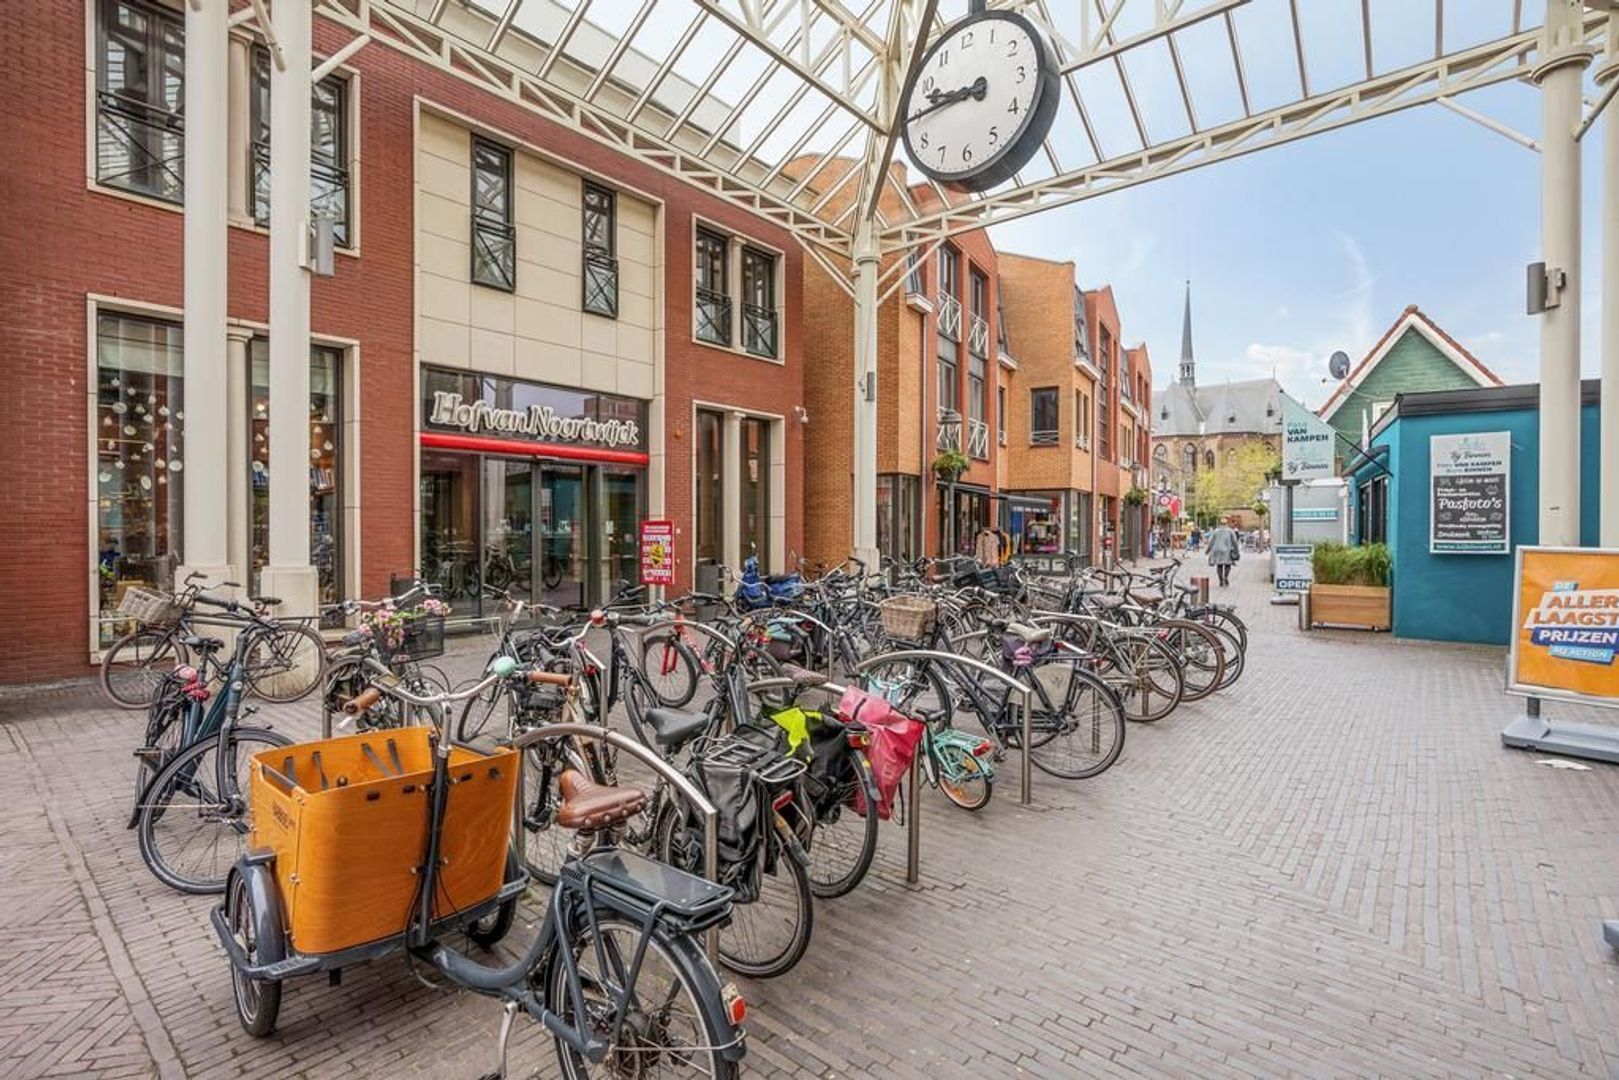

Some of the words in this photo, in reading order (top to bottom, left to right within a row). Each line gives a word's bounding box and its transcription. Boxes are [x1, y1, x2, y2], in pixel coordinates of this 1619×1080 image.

[960, 31, 974, 50] 12
[989, 28, 995, 44] 1
[1006, 40, 1018, 57] 2
[938, 50, 949, 67] 11
[1015, 66, 1026, 84] 3
[921, 76, 934, 94] 10
[1007, 97, 1019, 115] 4
[920, 132, 930, 150] 8
[988, 126, 998, 145] 5
[938, 145, 946, 164] 7
[962, 143, 972, 162] 6
[430, 391, 487, 431] Hof
[482, 407, 527, 433] van
[526, 404, 639, 447] Noortwijck
[1287, 434, 1329, 443] KAMPEN
[1439, 497, 1503, 510] Pasfoto's
[1279, 580, 1308, 589] OPEN
[1547, 594, 1619, 609] ALLER
[1538, 629, 1618, 644] PRIJZEN
